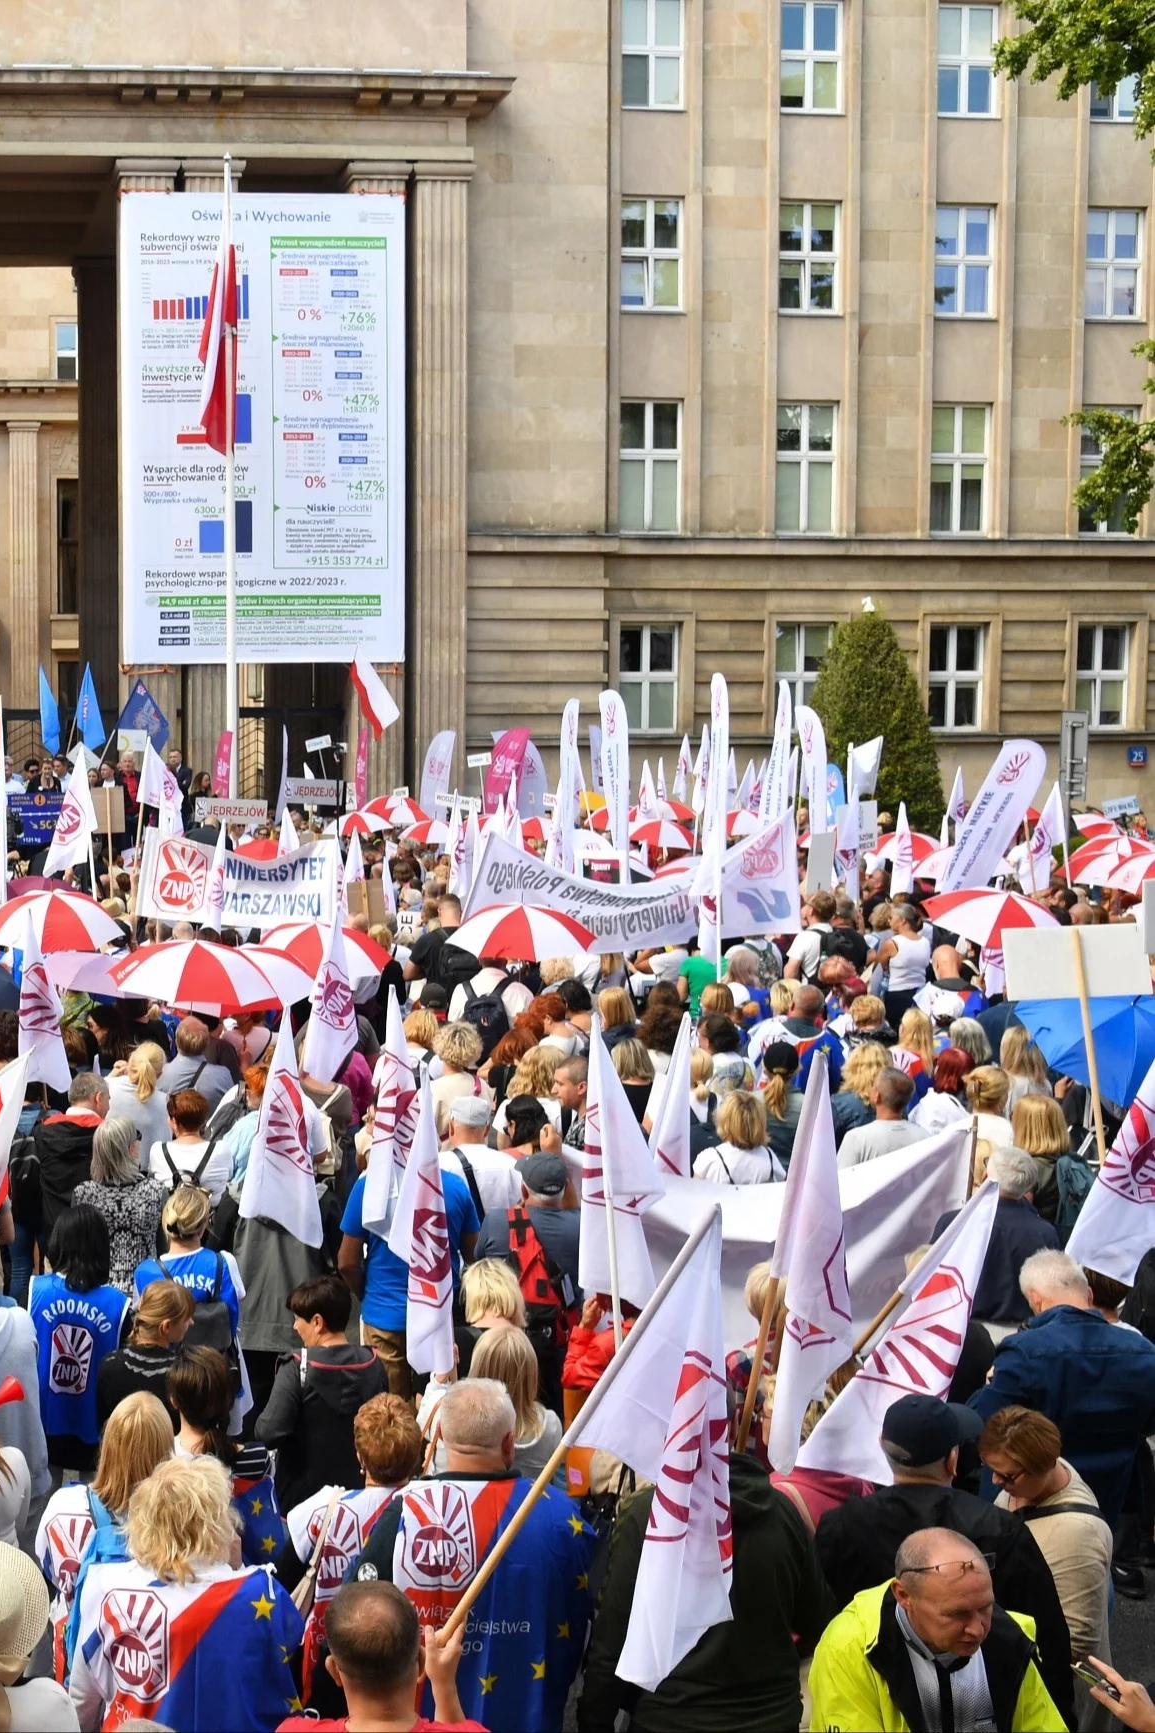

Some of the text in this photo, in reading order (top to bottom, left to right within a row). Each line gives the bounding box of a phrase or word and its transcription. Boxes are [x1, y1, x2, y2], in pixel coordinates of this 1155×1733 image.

[252, 211, 331, 224] Wychowanie
[140, 233, 194, 243] Rekordowy
[140, 243, 187, 252] subwencji
[298, 309, 306, 320] 0
[340, 312, 376, 324] +76%
[302, 390, 322, 402] 0%
[344, 394, 379, 406] +47%
[305, 476, 326, 488] 0%
[346, 480, 385, 493] +47%
[307, 504, 372, 515] Niskie podatki
[305, 557, 330, 565] +915
[333, 557, 351, 565] 353
[290, 577, 338, 586] 2022/2023
[1132, 751, 1144, 762] 25
[294, 786, 342, 799] JĘDRZEJÓW
[208, 804, 265, 821] JĘDRZEJÓW
[226, 857, 326, 882] NIWERSYTET
[162, 879, 194, 900] ZNP
[56, 1362, 80, 1380] ZNP
[414, 1538, 456, 1567] ZNP
[412, 1601, 475, 1620] wiązk
[111, 1644, 149, 1679] ZNP
